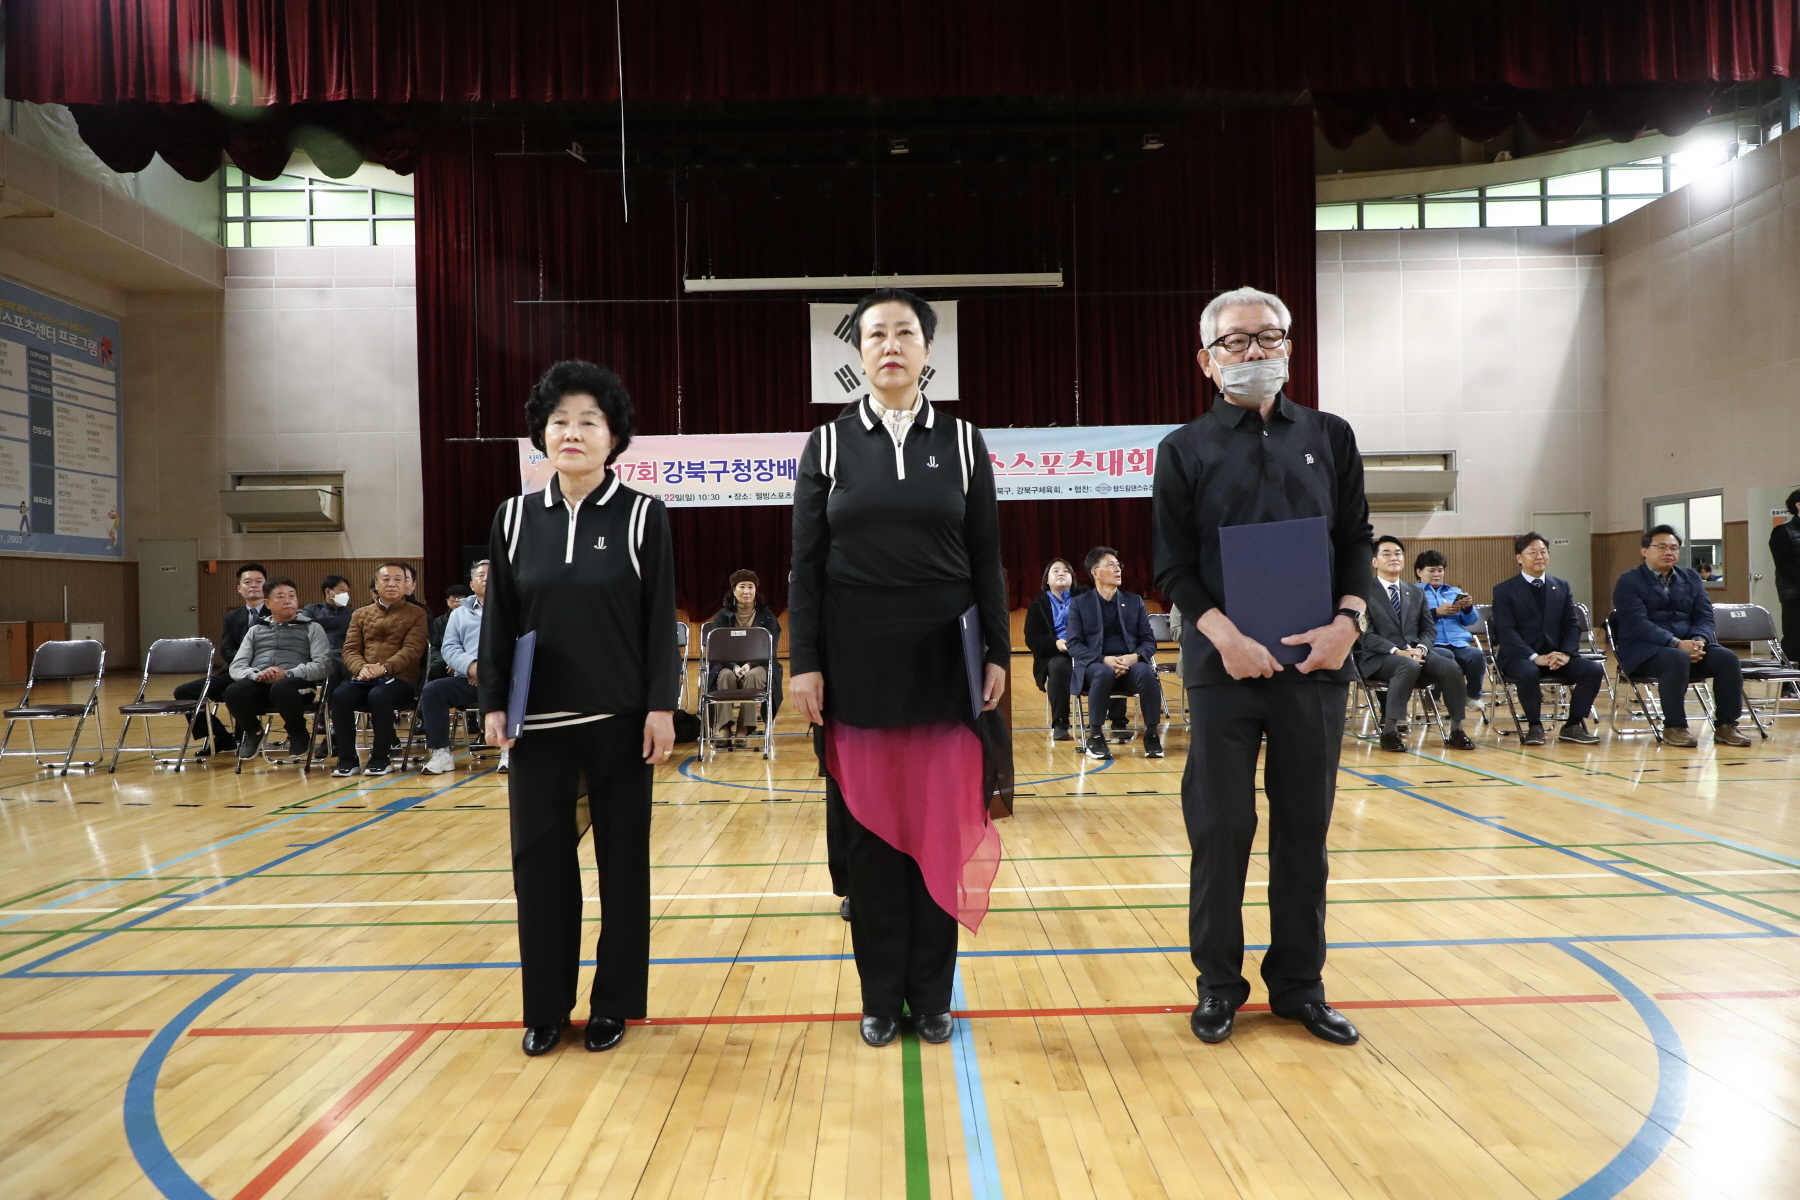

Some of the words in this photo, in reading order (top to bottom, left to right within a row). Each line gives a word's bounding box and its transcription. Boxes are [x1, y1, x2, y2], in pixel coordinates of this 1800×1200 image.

[0, 312, 57, 344] 스포츠센터
[58, 329, 98, 357] 프로그램
[32, 425, 52, 436] 건강교실
[606, 460, 658, 484] 17회
[662, 457, 797, 484] 강북구청장배
[33, 495, 53, 506] 체육교실
[664, 493, 696, 502] 22일(일)
[698, 493, 720, 502] 10:30
[734, 492, 752, 501] 장소:
[6, 536, 23, 544] 2903
